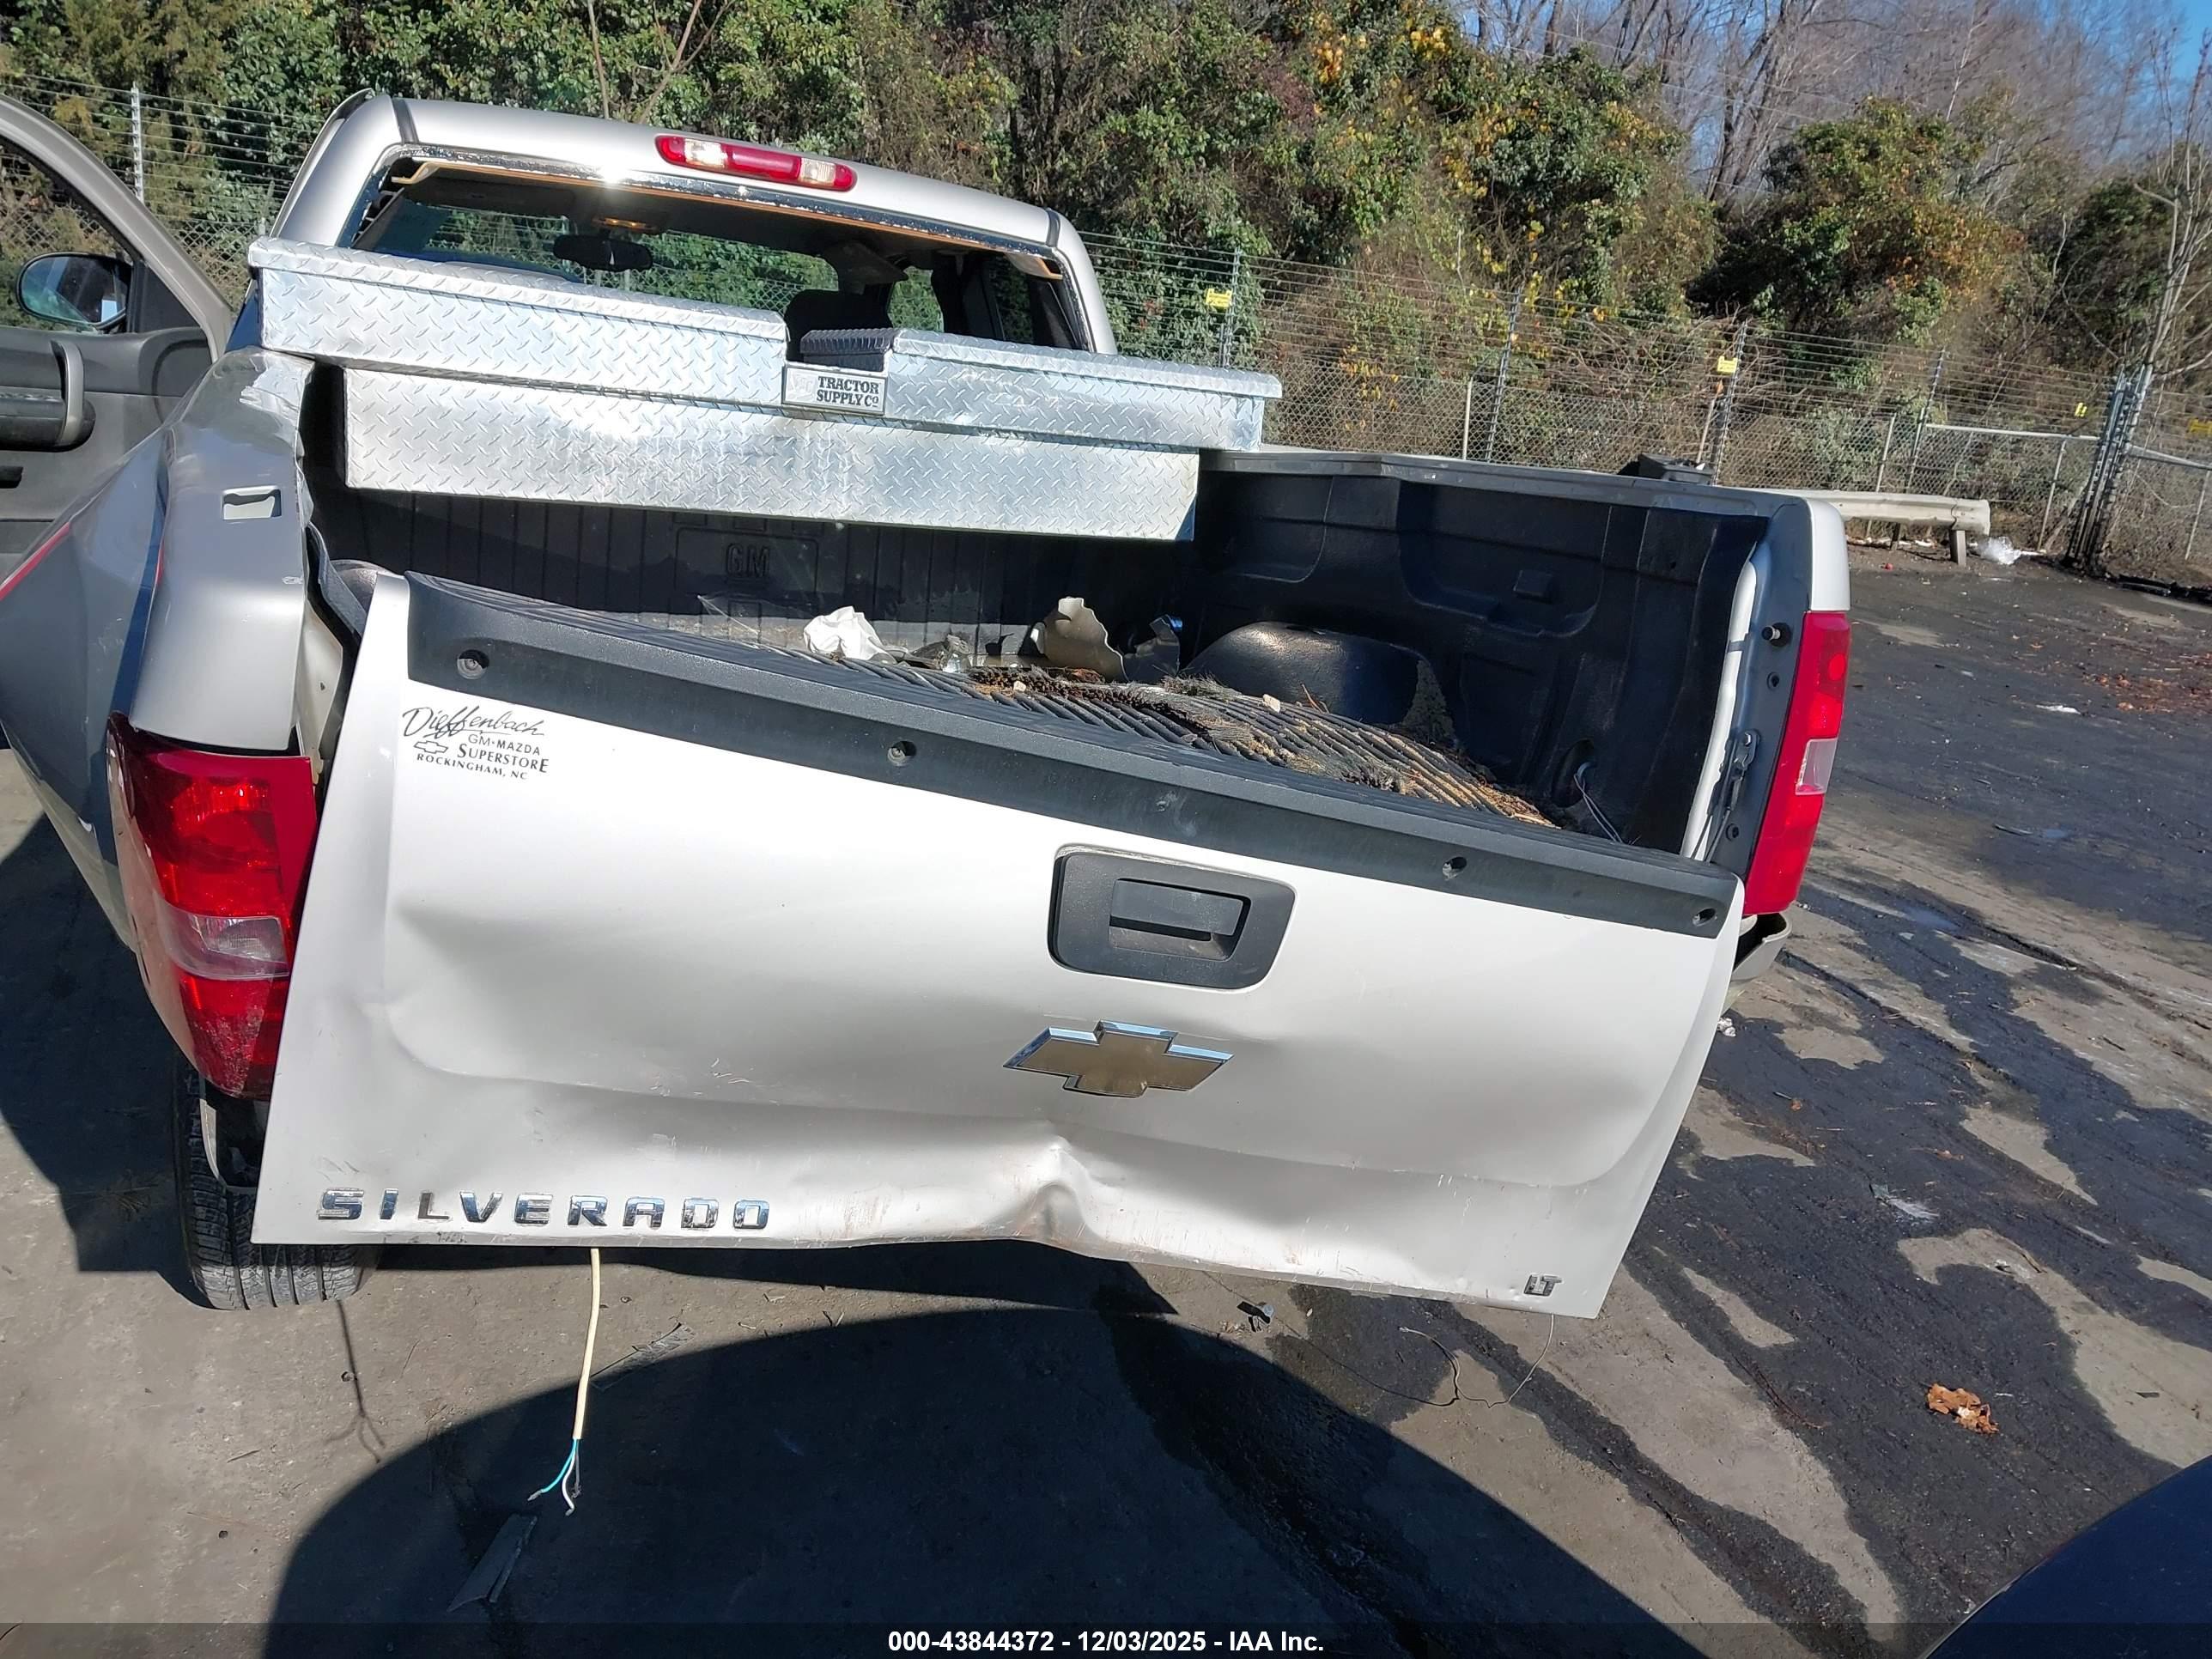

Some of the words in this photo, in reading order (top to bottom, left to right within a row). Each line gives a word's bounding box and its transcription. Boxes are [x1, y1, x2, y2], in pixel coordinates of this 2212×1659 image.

[817, 390, 863, 405] SUPPLY
[818, 376, 878, 394] TRACTOR
[726, 543, 770, 579] GM
[402, 706, 544, 739] Dieffenbach
[416, 753, 507, 778] ROCKINGHAM,
[510, 769, 528, 781] NC
[317, 1188, 771, 1231] SILVERADO
[1523, 1273, 1563, 1297] LT
